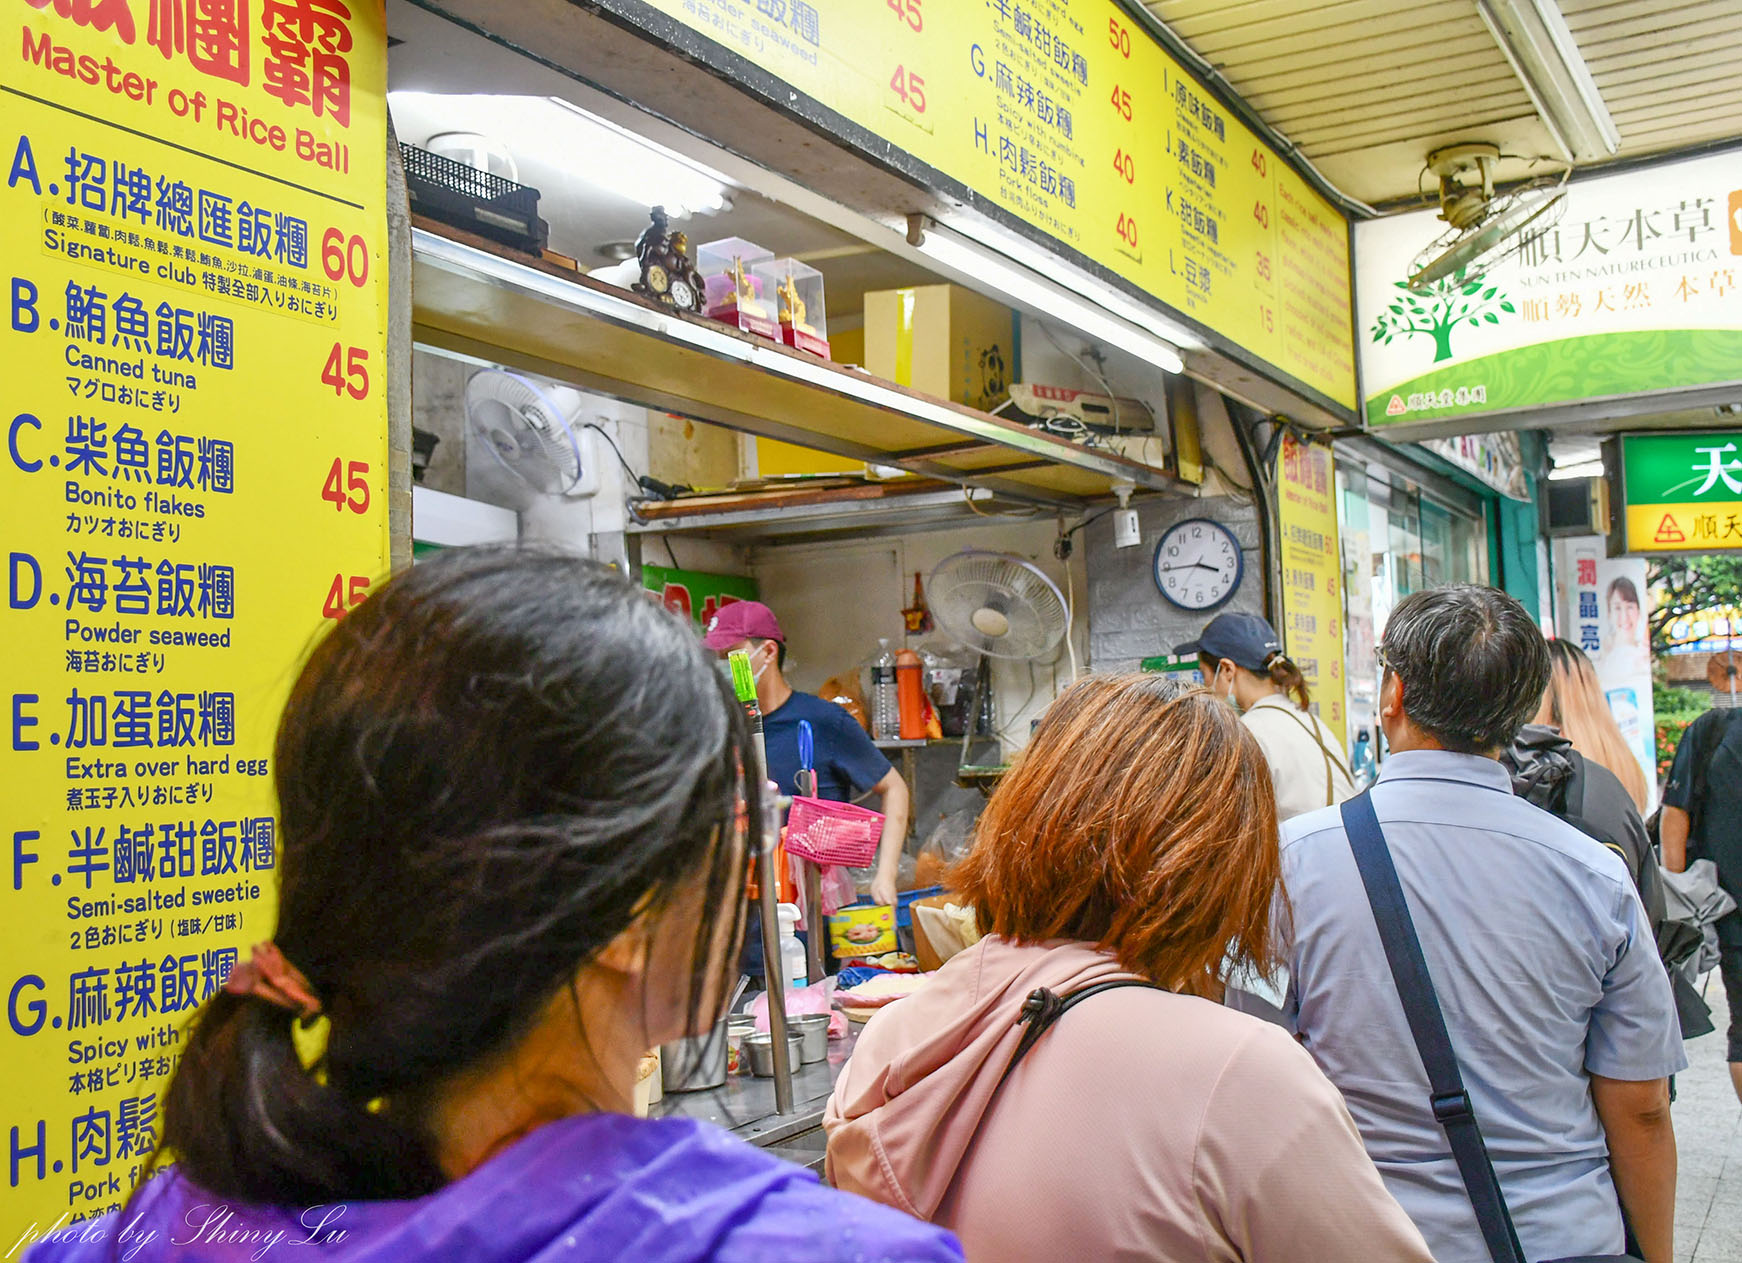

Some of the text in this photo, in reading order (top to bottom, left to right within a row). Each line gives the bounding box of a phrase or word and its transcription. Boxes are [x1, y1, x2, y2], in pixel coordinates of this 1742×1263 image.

[751, 18, 818, 66] seaweed
[1109, 17, 1131, 59] 50
[22, 26, 349, 174] Master of Rice Ball
[890, 64, 927, 114] 45
[1111, 84, 1132, 122] 45
[1113, 148, 1135, 185] 40
[1252, 148, 1267, 178] 40
[1116, 212, 1138, 248] 40
[1254, 200, 1269, 230] 40
[1520, 198, 1716, 268] 順天本草
[44, 228, 338, 321] Signature club 特製全部入りおにぎり
[321, 226, 369, 288] 60
[1256, 250, 1271, 282] 35
[1520, 249, 1719, 289] SUN TEN NATURECEUTICA
[1522, 268, 1738, 322] 順勢天然 本草
[1260, 304, 1274, 334] 15
[65, 344, 197, 390] Canned tuna
[321, 342, 370, 401] 45
[65, 376, 181, 414] マグロおにぎり
[65, 481, 206, 519] Bonito flakes
[322, 457, 370, 515] 45
[66, 513, 181, 543] カツオおにぎり
[1191, 526, 1202, 538] 12
[1168, 545, 1180, 557] 10
[1221, 541, 1229, 553] 2
[1226, 556, 1234, 569] 3
[1168, 577, 1176, 589] 8
[1180, 587, 1189, 600] 7
[1211, 585, 1219, 598] 5
[1221, 573, 1230, 584] 4
[1195, 591, 1204, 603] 6
[65, 619, 231, 648] Powder seaweed
[65, 650, 165, 674] 海苔おにぎり
[66, 754, 268, 780] Extra over hard egg
[66, 783, 214, 812] 煮玉子入りおにぎり
[67, 880, 261, 920] Semi-salted sweetie
[68, 1037, 129, 1064] Spicy
[136, 1023, 179, 1051] with
[69, 1172, 120, 1206] Pork
